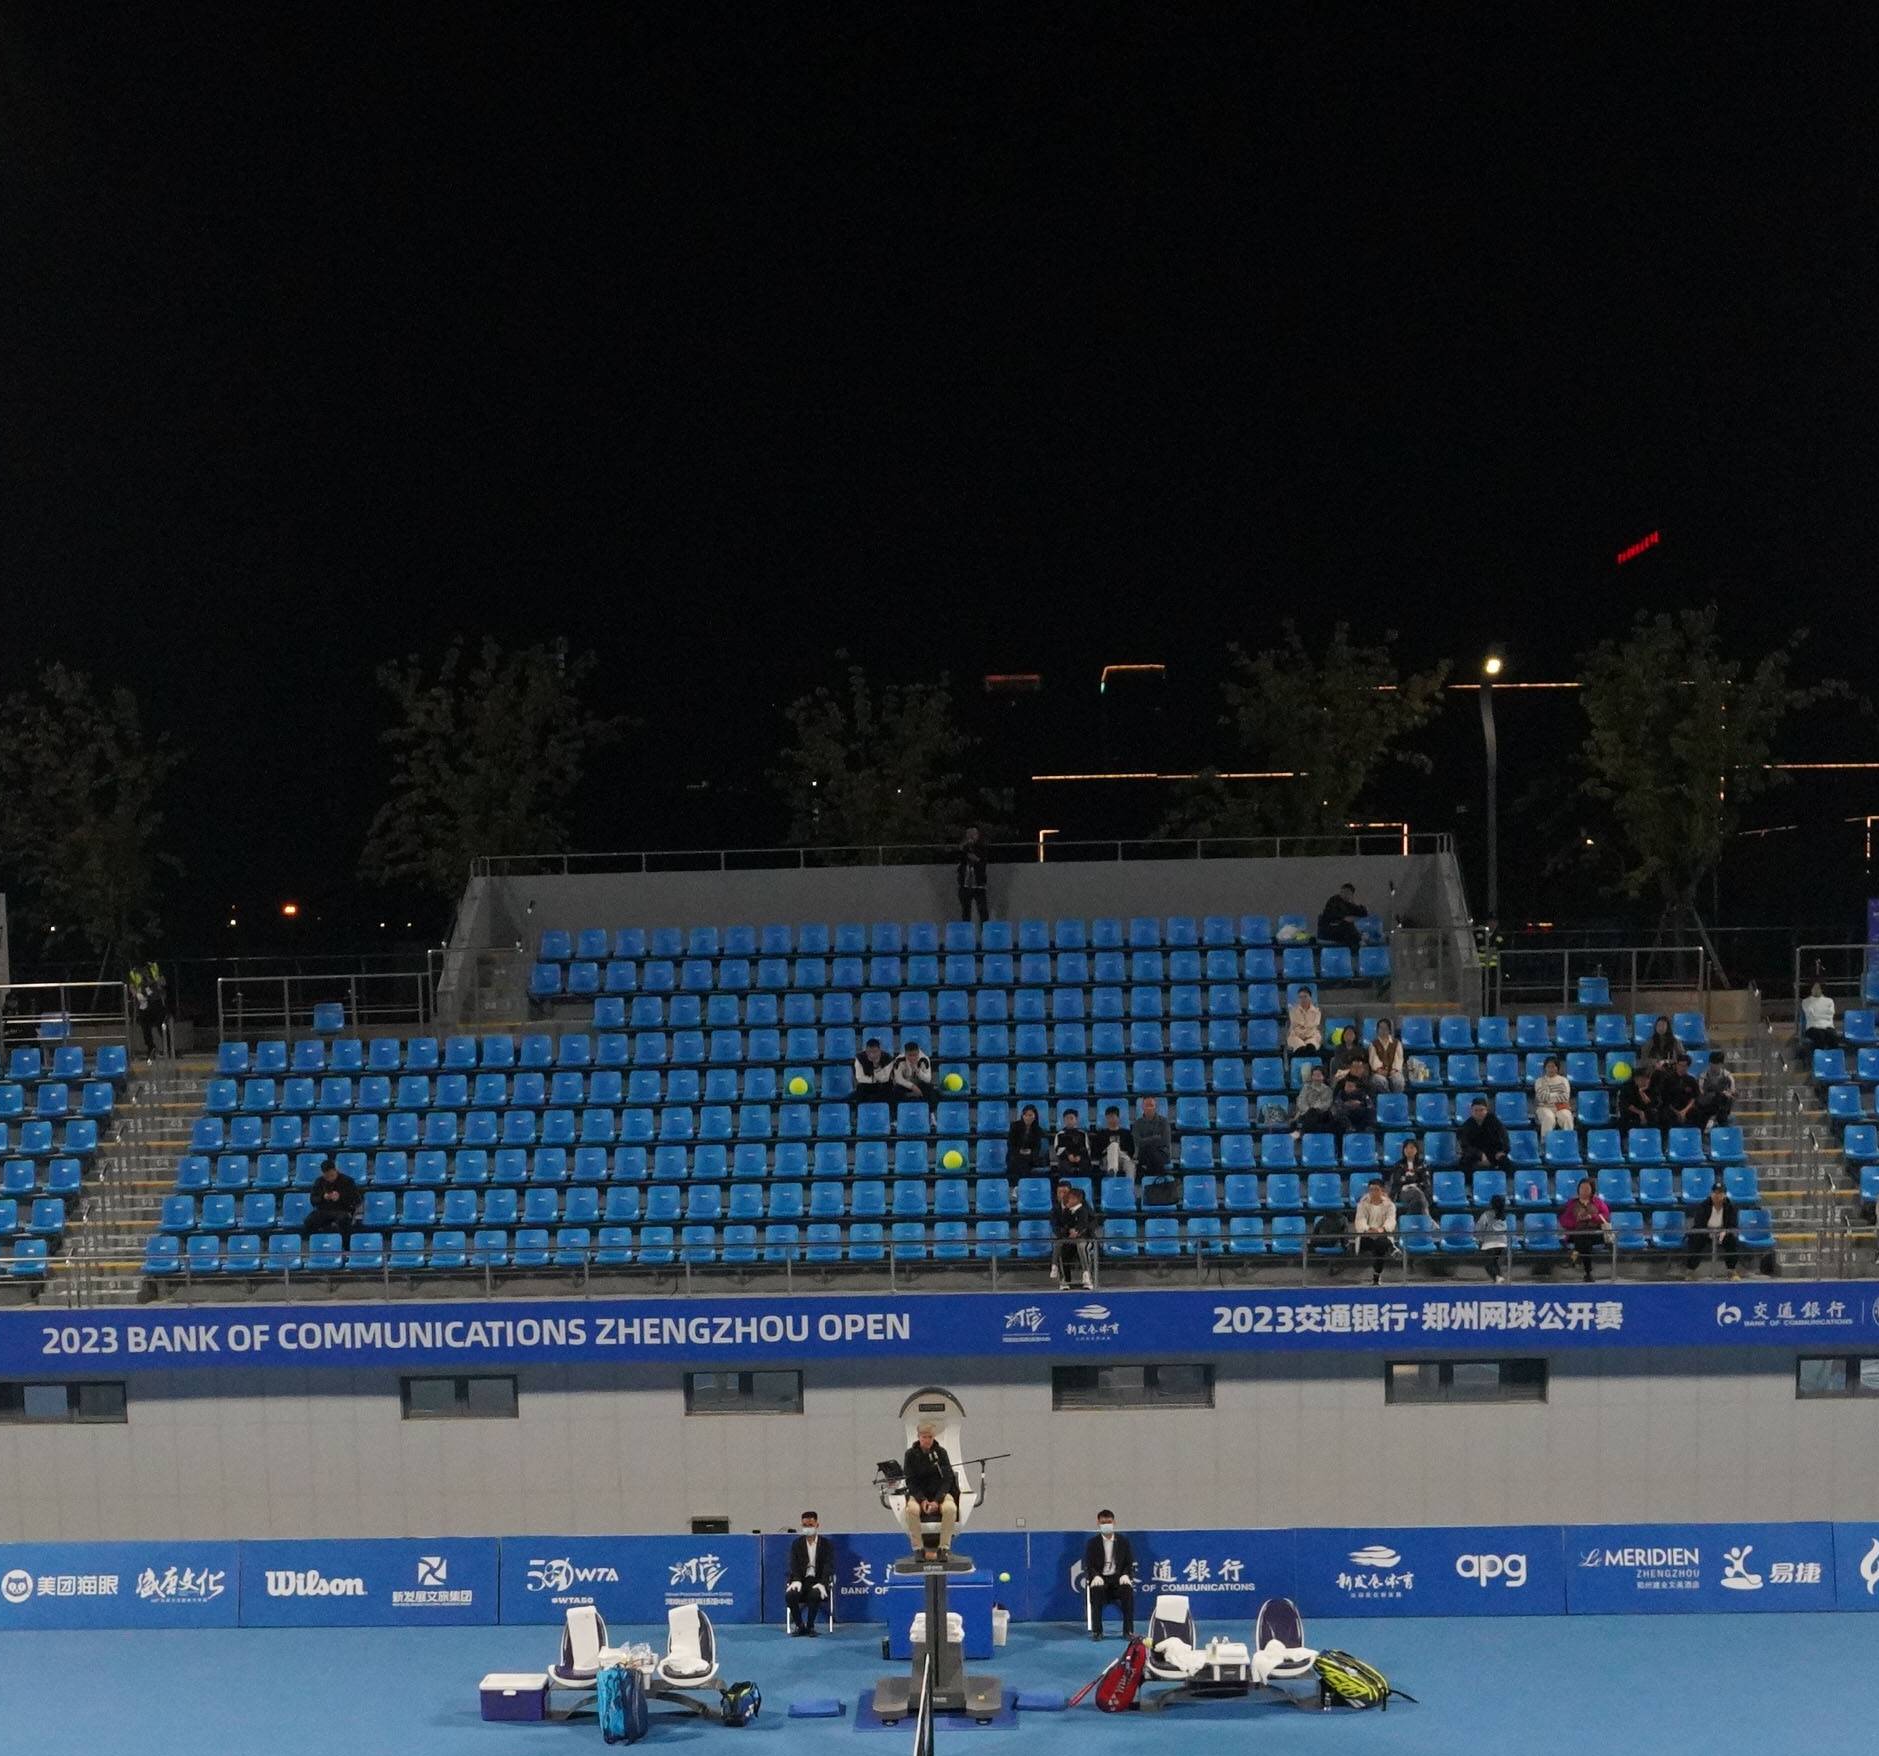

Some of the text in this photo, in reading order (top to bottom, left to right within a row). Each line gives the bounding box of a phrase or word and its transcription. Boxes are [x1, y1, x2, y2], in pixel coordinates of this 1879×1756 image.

[1212, 1300, 1624, 1334] 2023交通银行·郑州网球公开赛
[1753, 1300, 1846, 1320] 交通銀行
[42, 1313, 910, 1354] 2023 BANK OF COMMUNICATIONS ZHENGZHOU OPEN
[574, 1567, 619, 1582] WTA
[1455, 1554, 1527, 1588] apg
[1636, 1568, 1700, 1579] ZHENGZHOU
[1769, 1562, 1822, 1584] 易捷
[37, 1575, 119, 1596] 美团猫眼
[264, 1569, 365, 1597] Wilson
[840, 1586, 889, 1595] BANK OF
[1141, 1584, 1157, 1593] OF
[1160, 1582, 1256, 1592] COMMUNICATIONS
